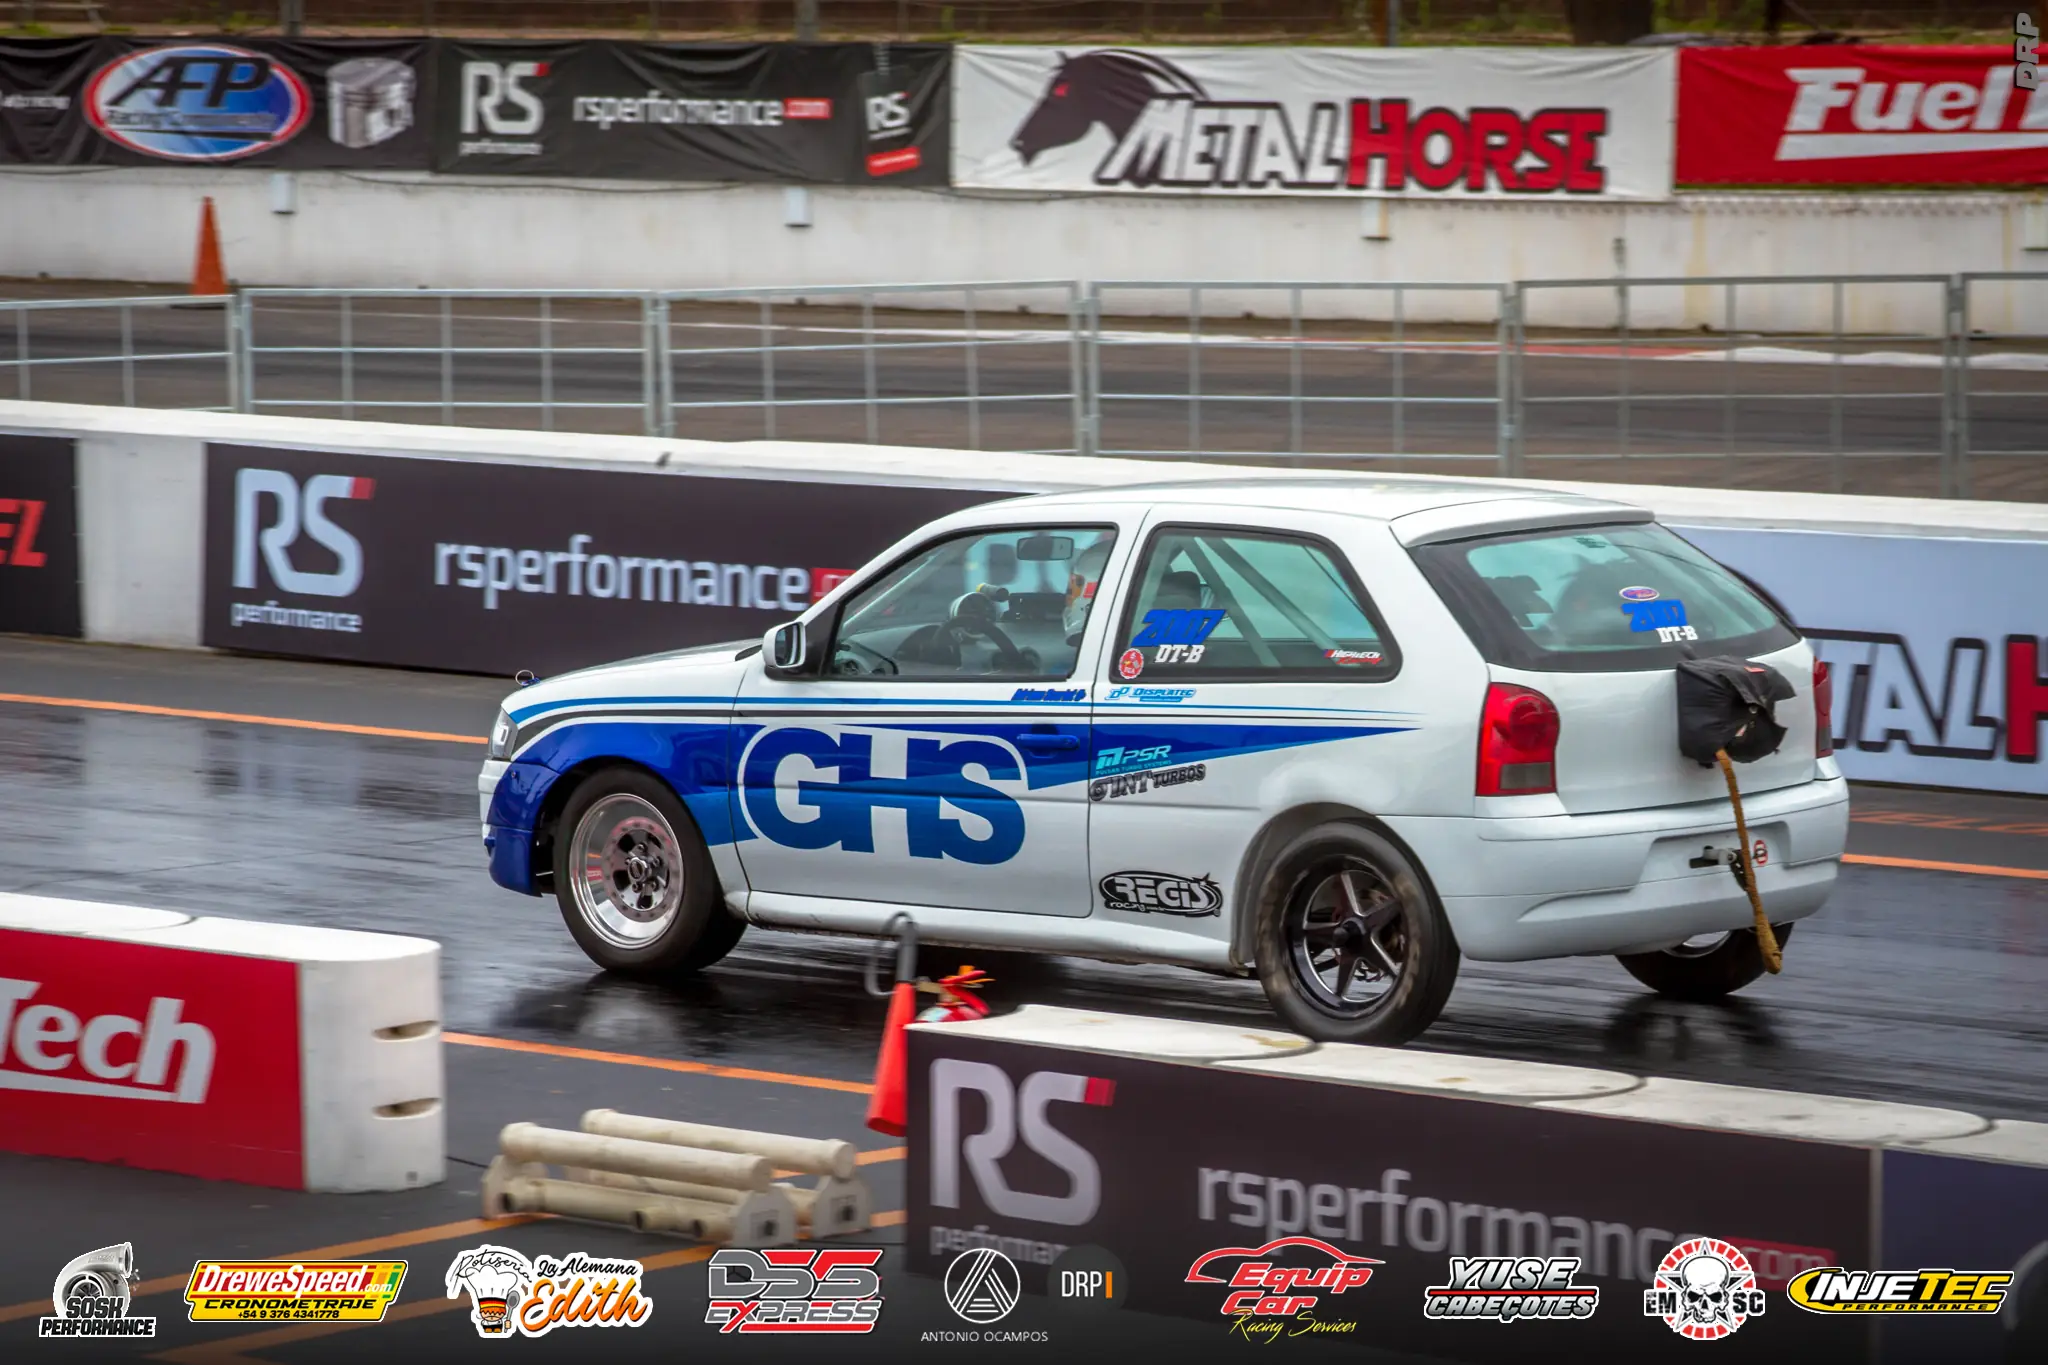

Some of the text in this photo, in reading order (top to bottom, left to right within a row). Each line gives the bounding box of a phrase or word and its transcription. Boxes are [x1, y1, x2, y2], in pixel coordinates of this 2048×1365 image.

[106, 56, 272, 108] AFP
[461, 61, 551, 134] RS
[232, 468, 376, 597] RS
[231, 600, 362, 633] performance
[743, 727, 1026, 865] GHS
[929, 1058, 1117, 1226] RS
